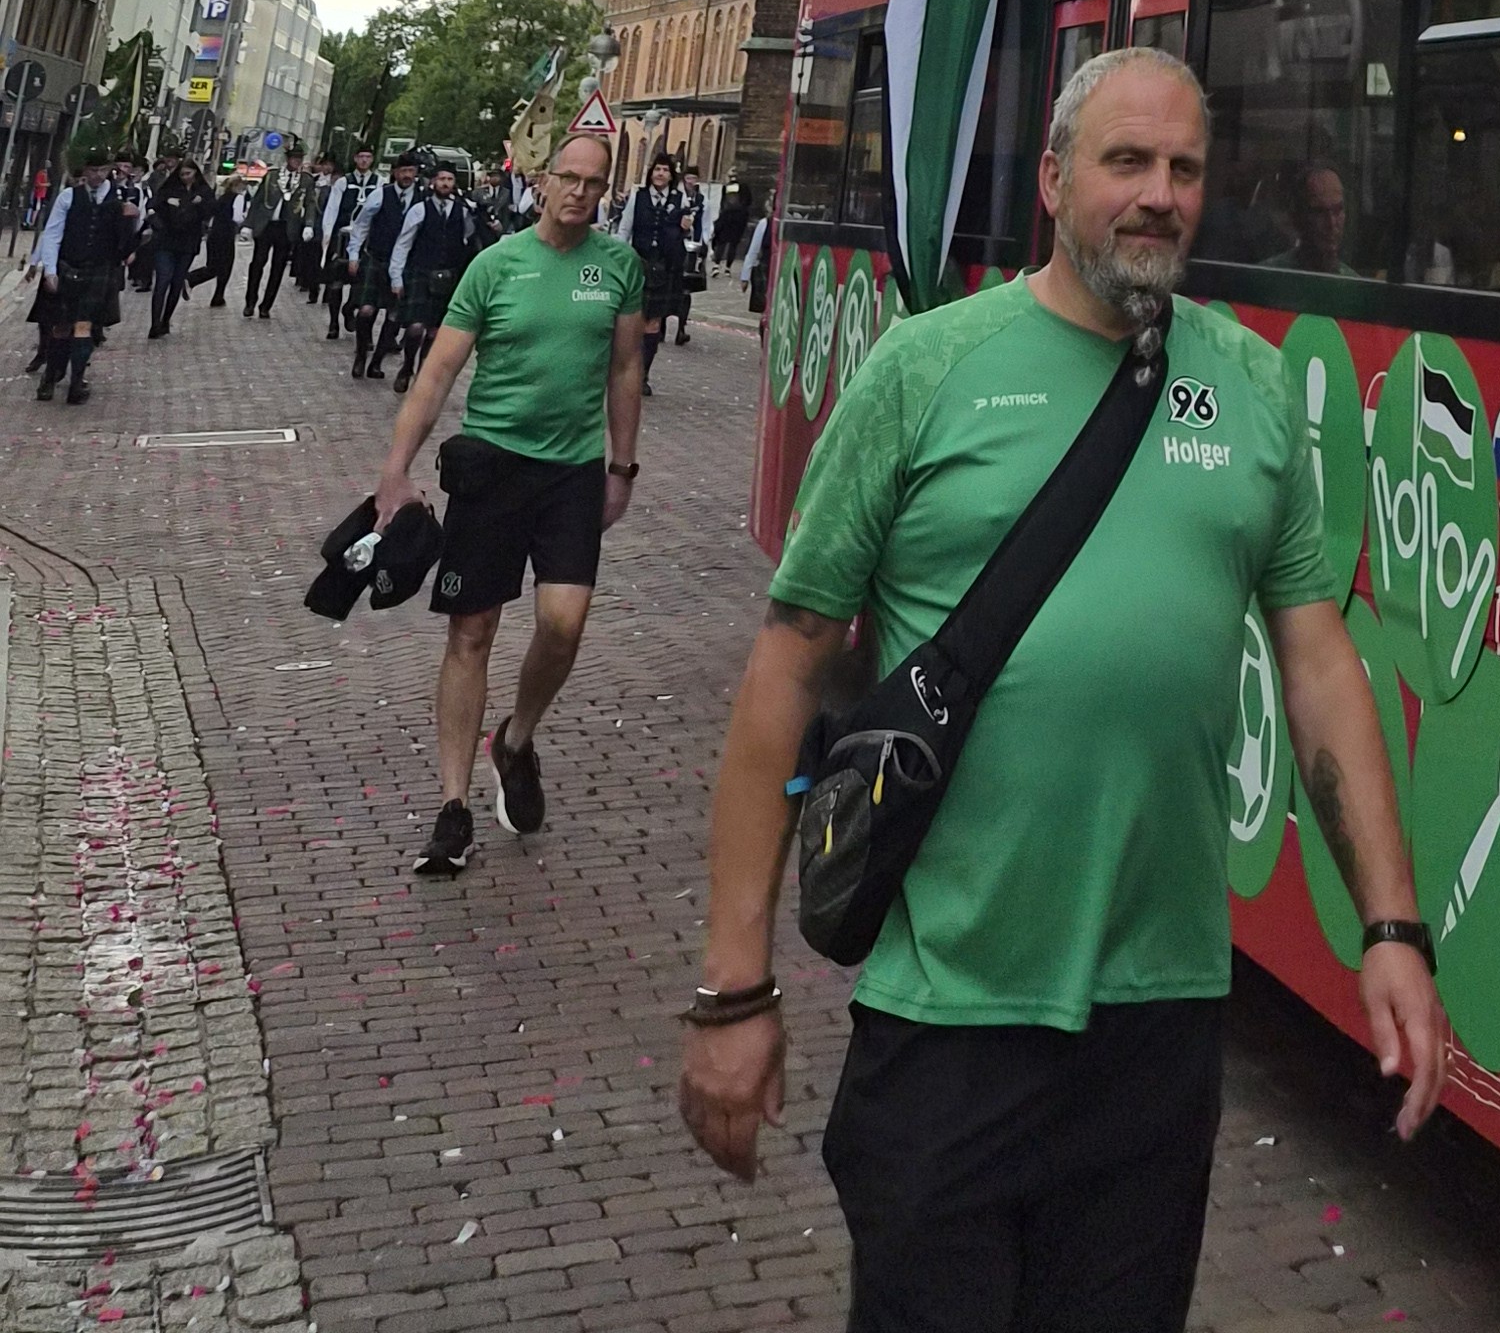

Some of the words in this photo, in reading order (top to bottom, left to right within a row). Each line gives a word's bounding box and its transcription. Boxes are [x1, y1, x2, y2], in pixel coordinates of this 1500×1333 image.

[211, 2, 227, 18] P
[581, 266, 602, 284] 96
[571, 288, 611, 302] Christian
[991, 392, 1048, 409] PATRICK
[1170, 383, 1216, 424] 96
[1163, 436, 1231, 471] Holger
[442, 574, 461, 594] 96
